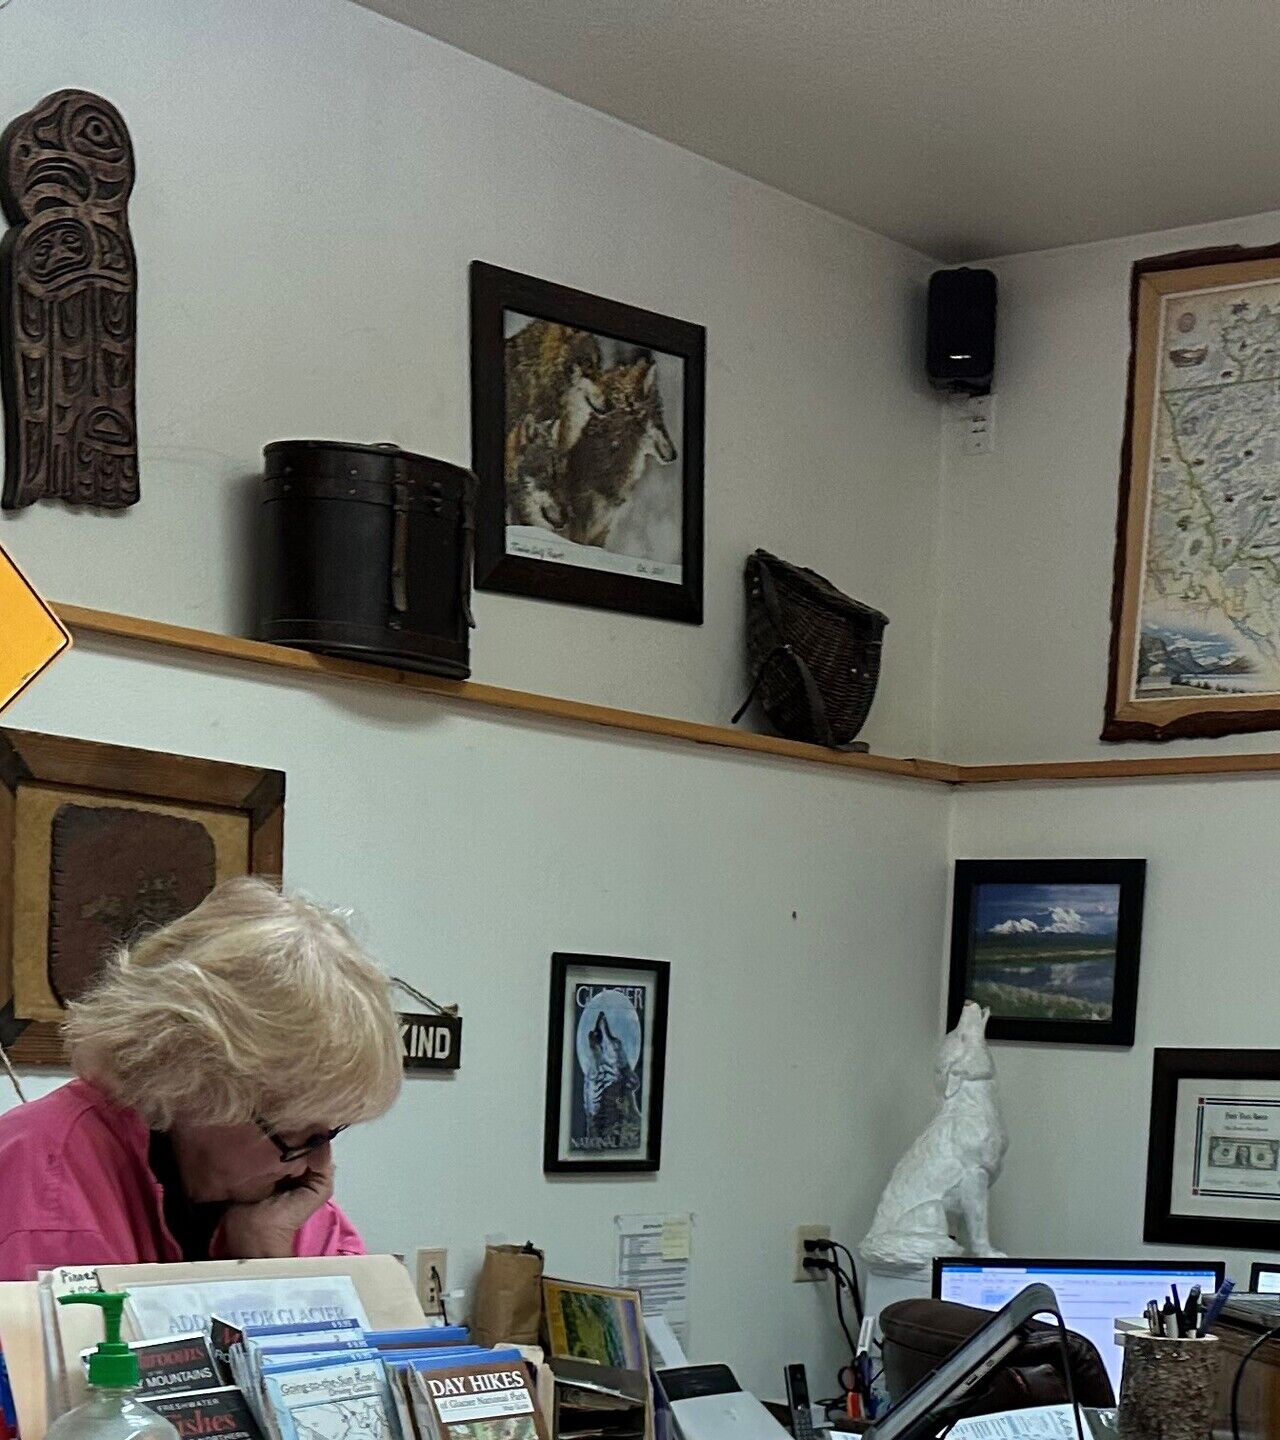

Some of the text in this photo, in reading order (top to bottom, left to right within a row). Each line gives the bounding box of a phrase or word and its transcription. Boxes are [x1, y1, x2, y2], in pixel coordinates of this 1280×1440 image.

[277, 1305, 345, 1326] GLACIER
[145, 1366, 214, 1388] MOUNTAINS
[427, 1370, 525, 1397] DAY HIKES
[156, 1398, 221, 1412] FRESHWATER
